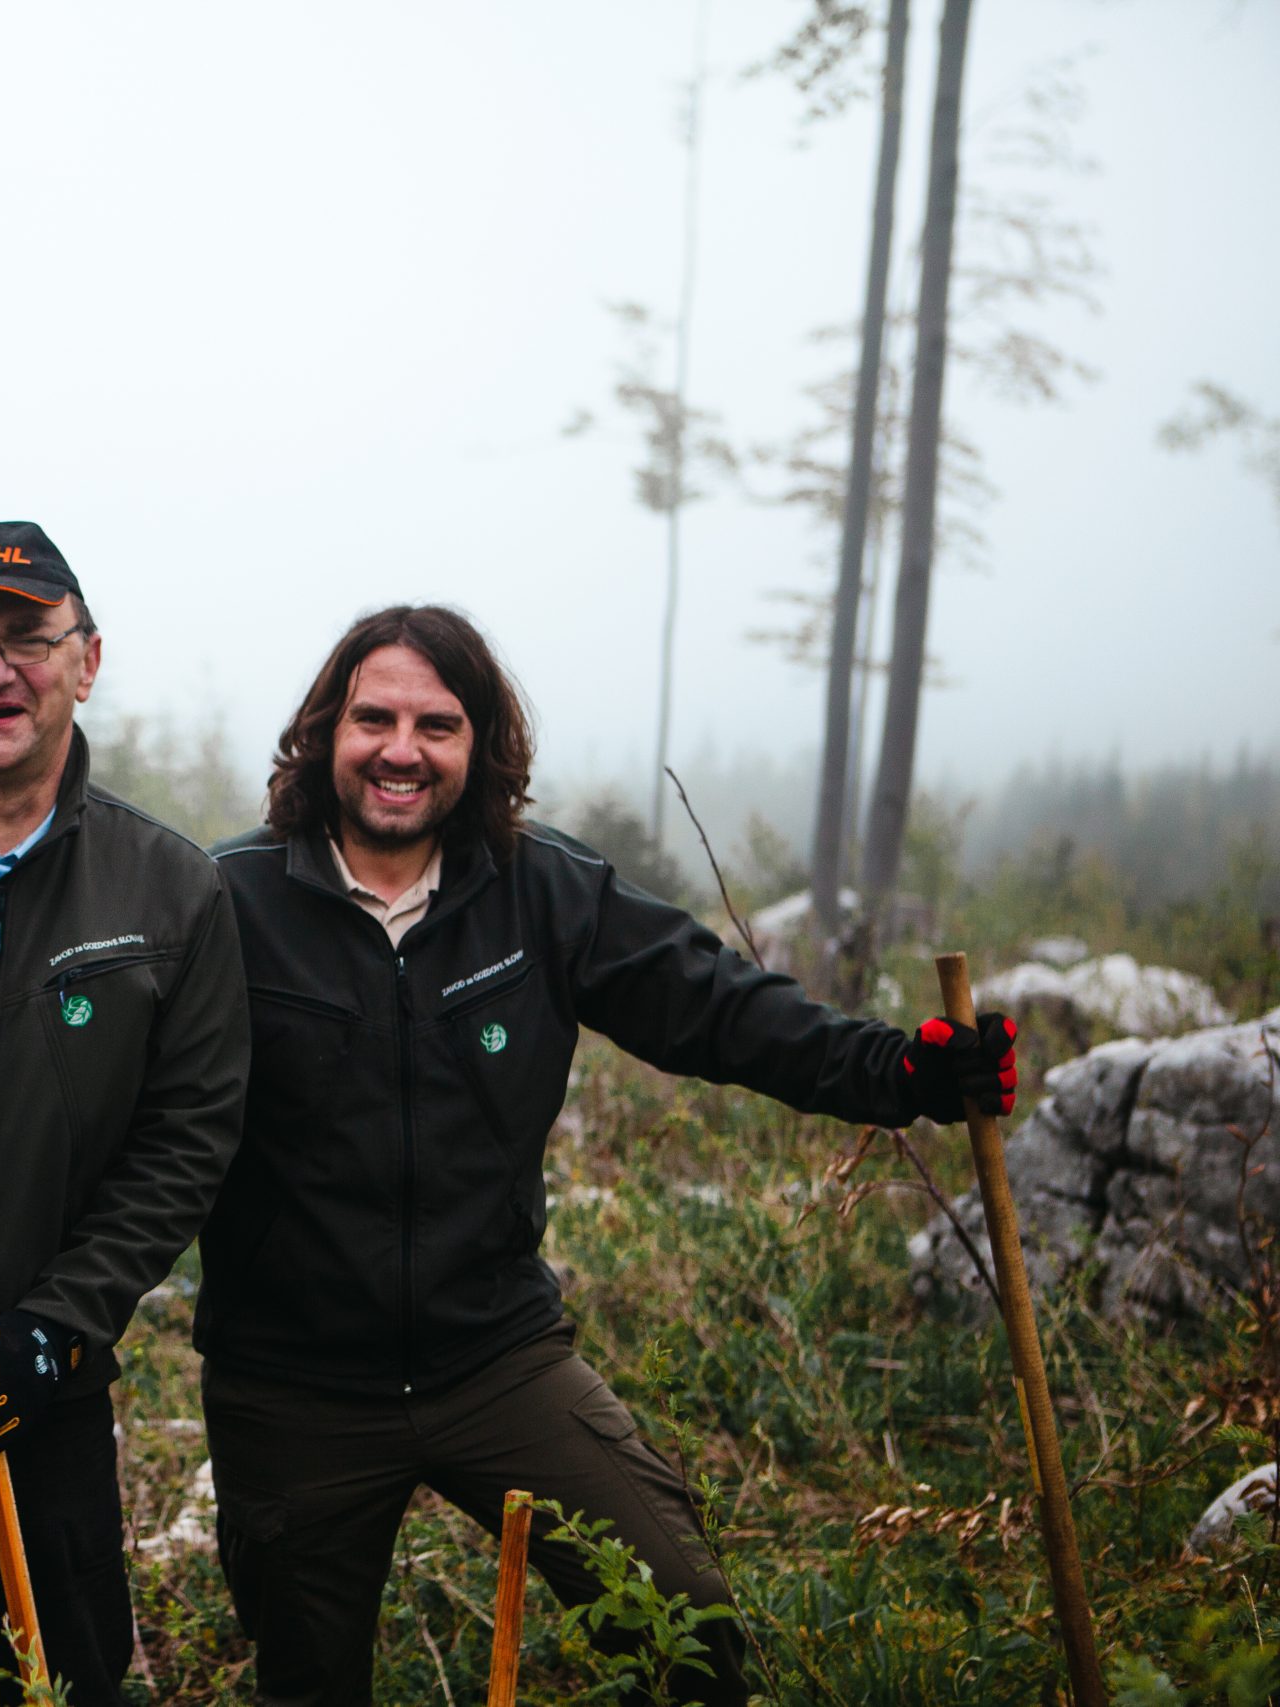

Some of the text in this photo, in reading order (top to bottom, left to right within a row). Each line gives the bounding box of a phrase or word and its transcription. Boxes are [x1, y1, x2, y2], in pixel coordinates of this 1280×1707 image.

[49, 948, 74, 966] ZAVOD
[83, 938, 118, 951] GOZDOVE
[441, 979, 466, 997] ZAVOD
